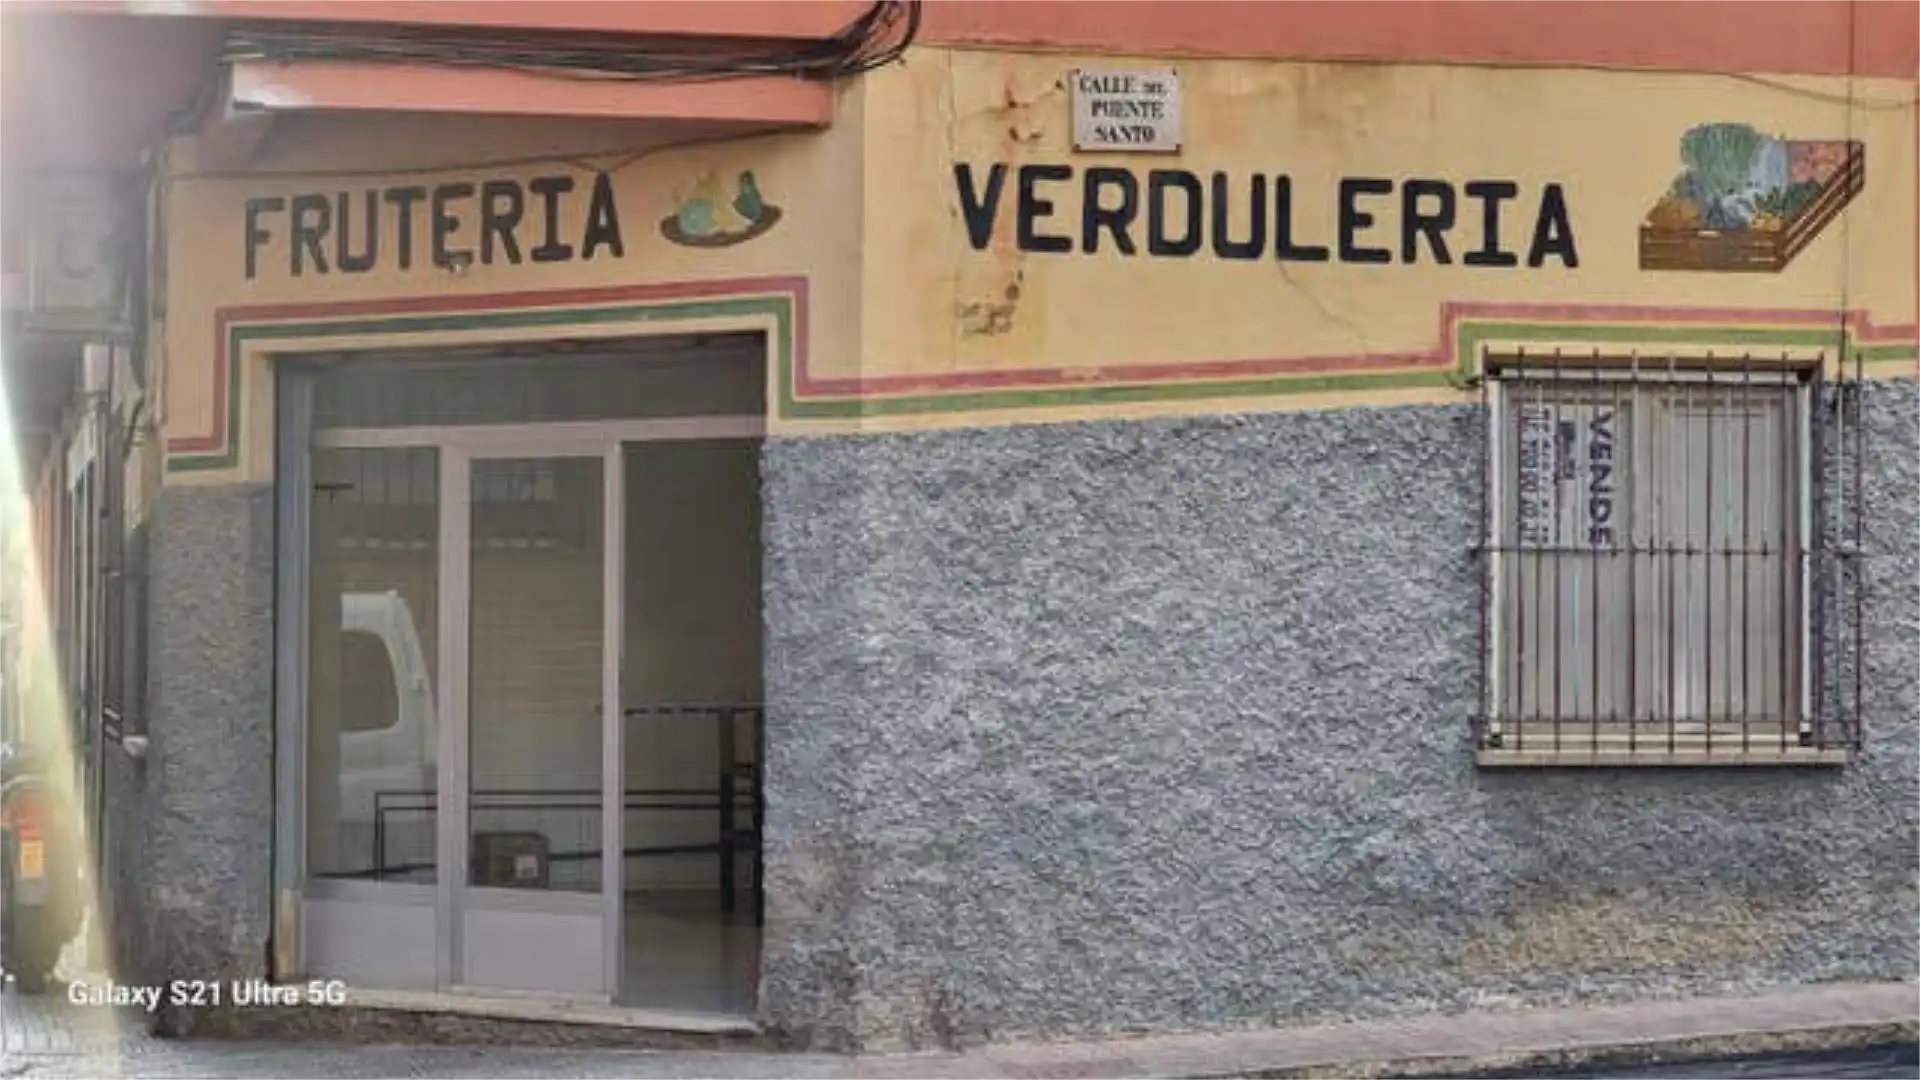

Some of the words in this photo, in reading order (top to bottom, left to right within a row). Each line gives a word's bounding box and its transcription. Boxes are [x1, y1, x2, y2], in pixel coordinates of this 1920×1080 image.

[1080, 75, 1137, 94] CALLE
[1091, 99, 1165, 119] PUENTE
[1094, 124, 1156, 143] SANTO
[243, 169, 625, 281] FRUTERIA
[952, 162, 1580, 269] VERDULERIA
[1589, 412, 1614, 545] VENDE
